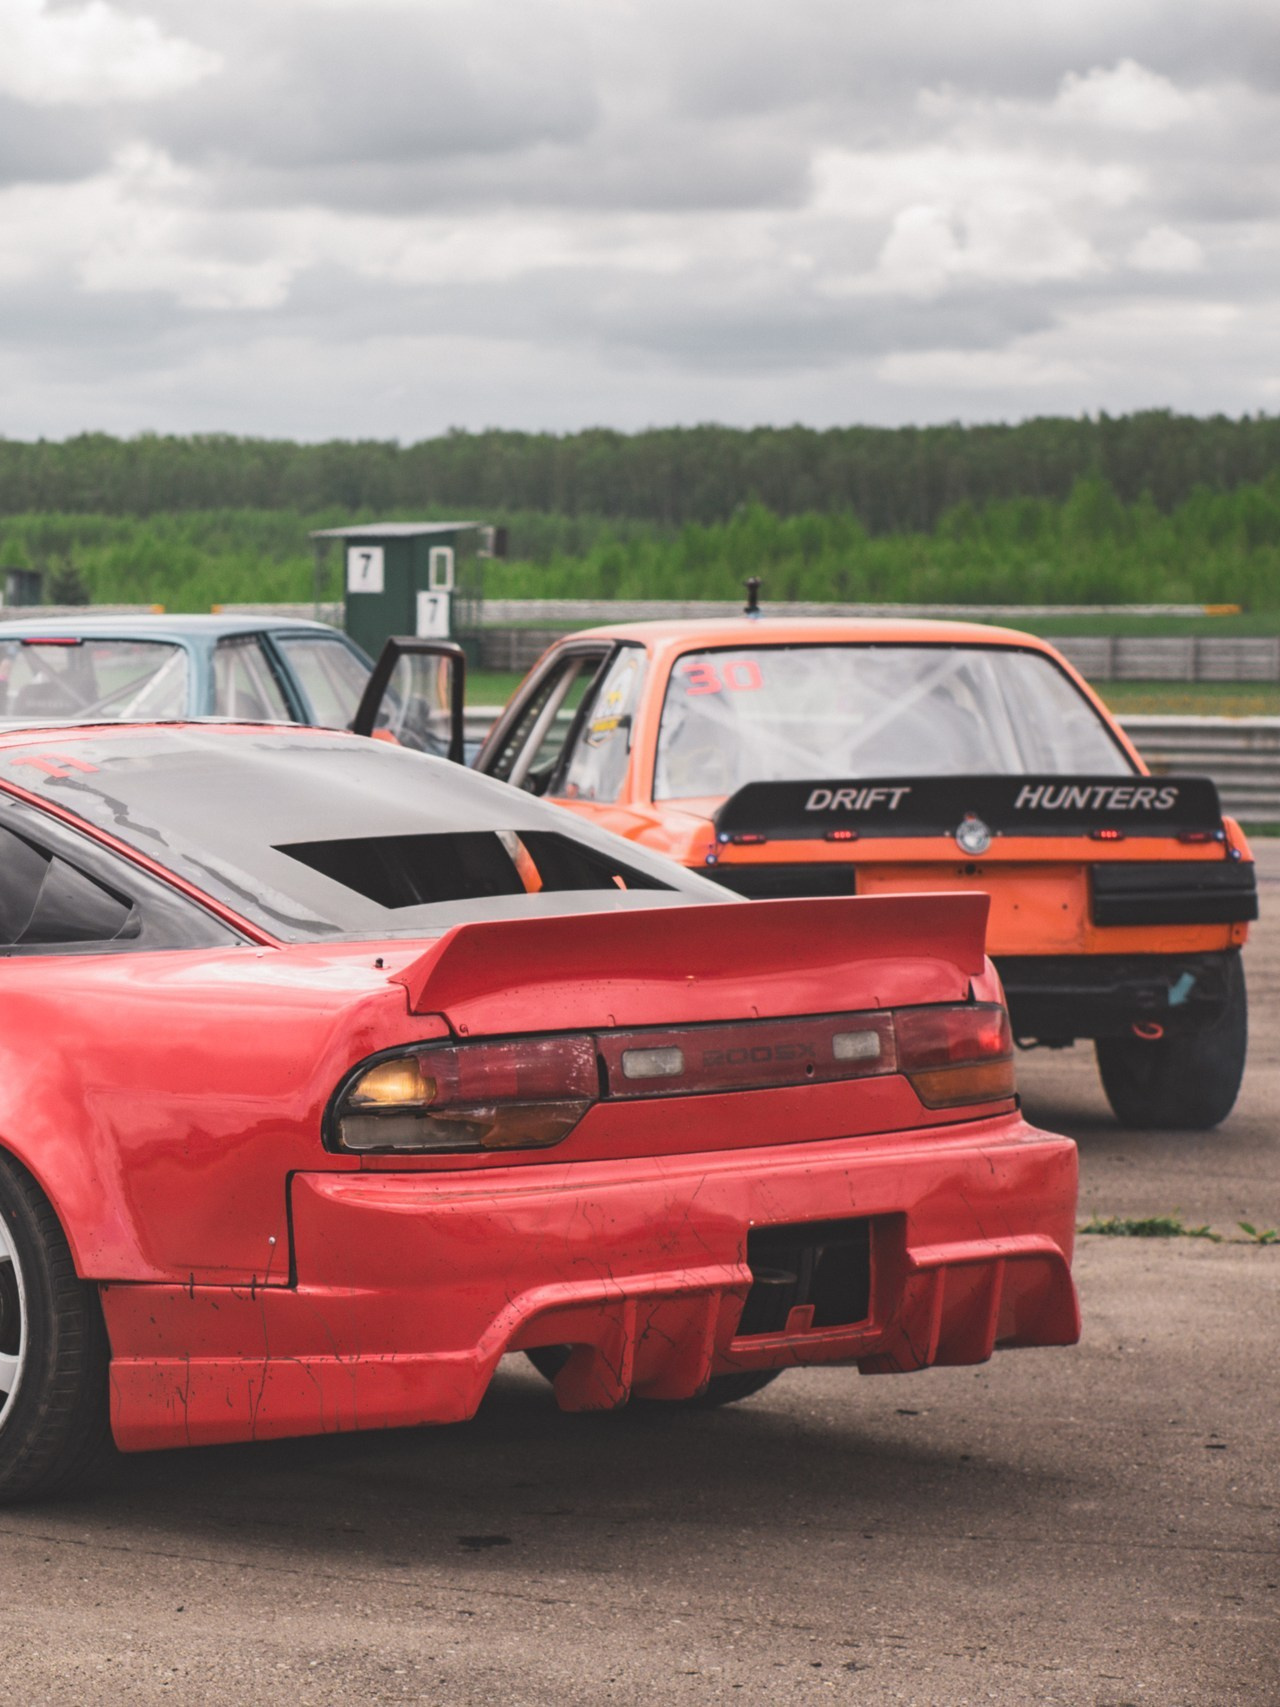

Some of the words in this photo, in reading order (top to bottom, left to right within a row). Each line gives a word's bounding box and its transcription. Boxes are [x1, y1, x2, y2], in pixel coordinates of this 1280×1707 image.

[360, 553, 372, 579] 7
[428, 598, 439, 624] 7
[681, 660, 765, 696] 30
[805, 786, 911, 811] DRIFT
[1014, 785, 1179, 810] HUNTERS
